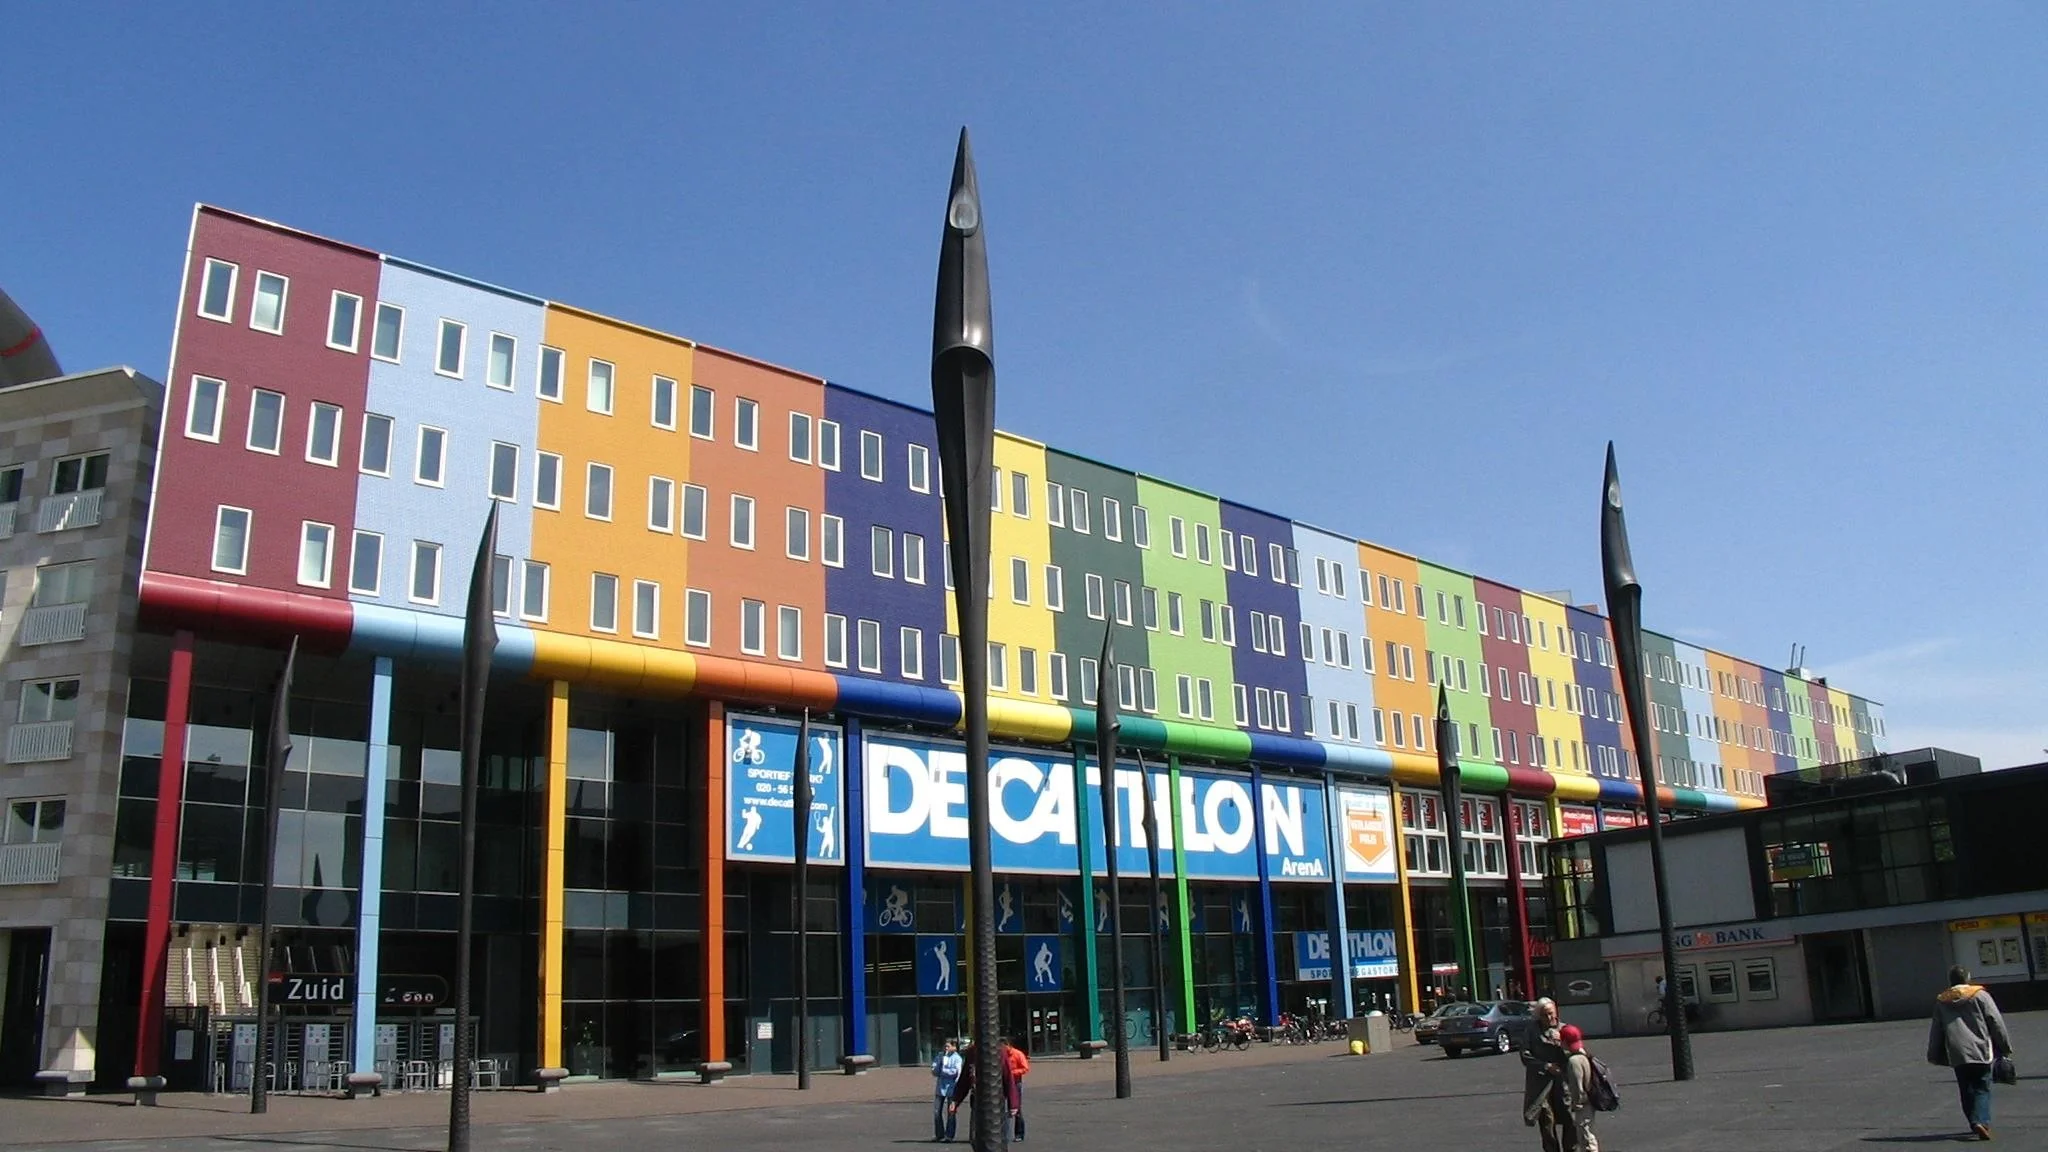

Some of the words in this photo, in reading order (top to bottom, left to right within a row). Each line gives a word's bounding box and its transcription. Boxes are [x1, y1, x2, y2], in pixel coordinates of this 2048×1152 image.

[748, 768, 791, 780] SPORTIEF
[868, 743, 1304, 856] DECATHLON
[1282, 857, 1324, 876] ArenA
[1307, 932, 1397, 959] DETHLON
[1716, 927, 1764, 944] BANK
[288, 978, 344, 1000] Zuid
